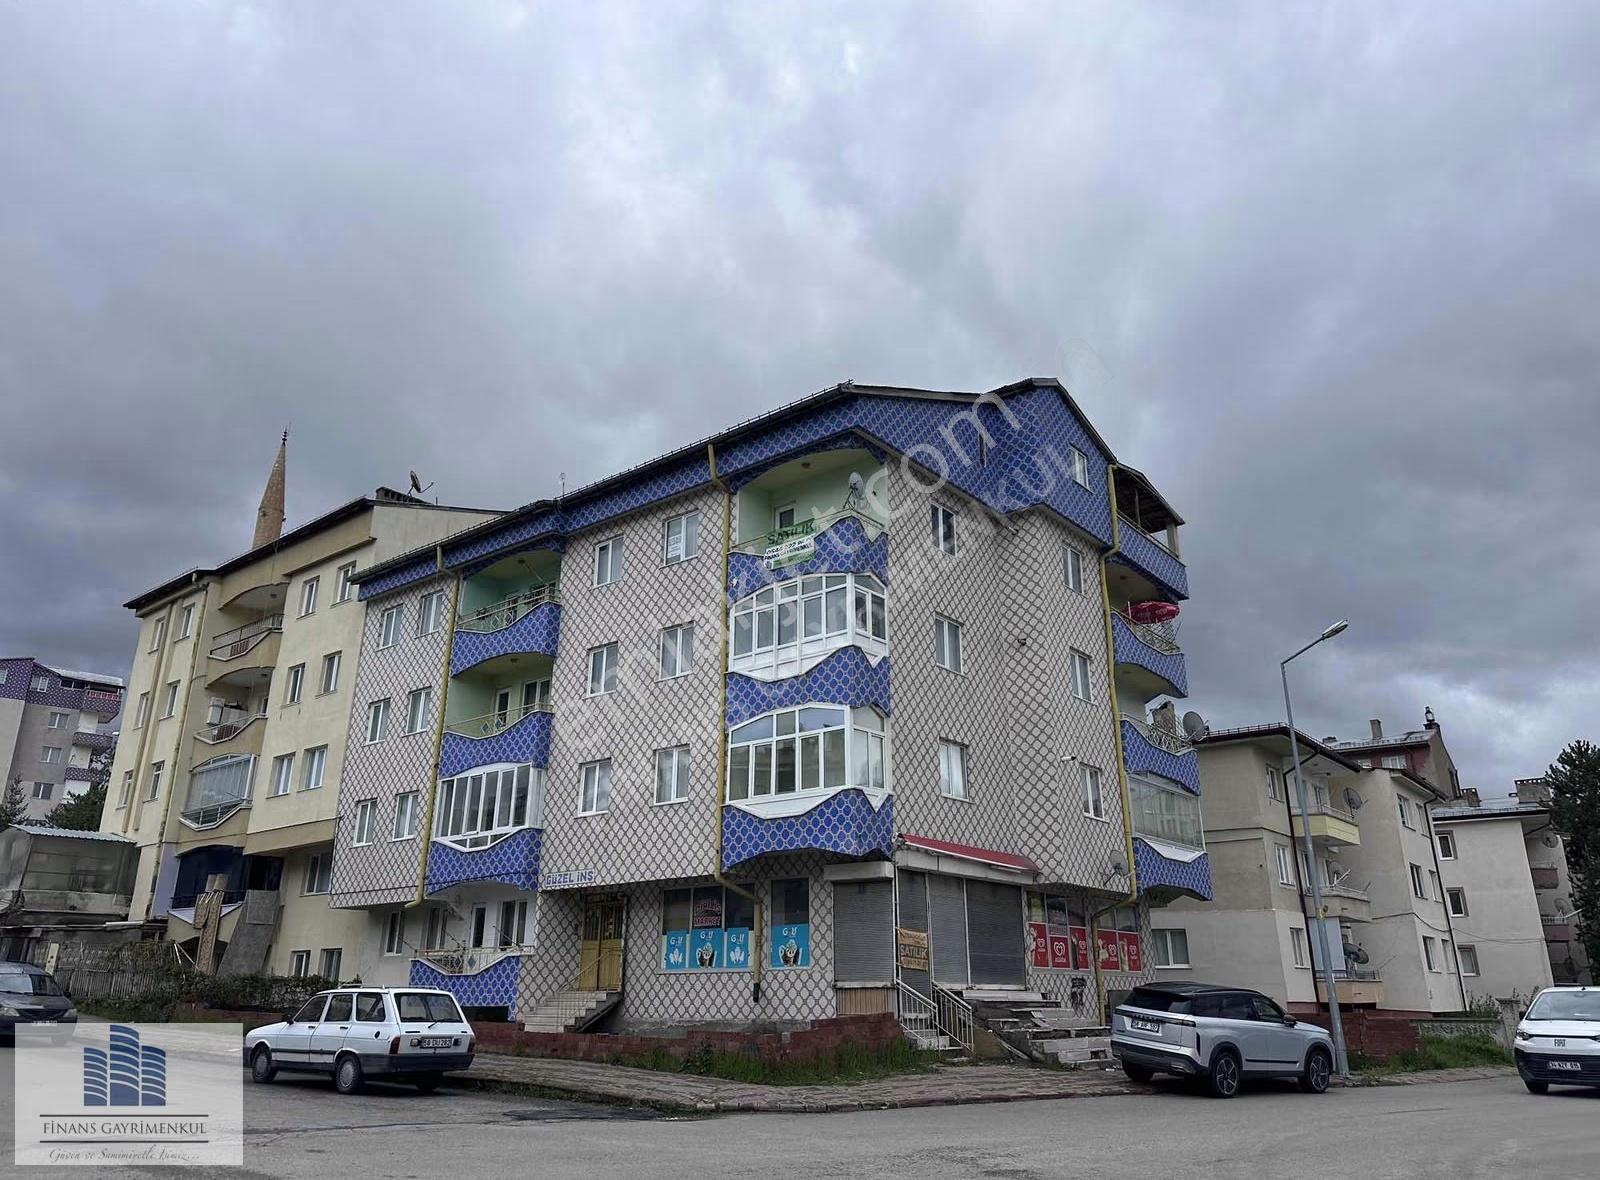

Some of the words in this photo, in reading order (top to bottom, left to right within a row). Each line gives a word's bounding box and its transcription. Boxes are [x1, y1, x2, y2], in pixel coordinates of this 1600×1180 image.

[767, 522, 815, 545] SATILIK
[546, 873, 574, 885] GÜZEL
[900, 944, 928, 959] SATILIK
